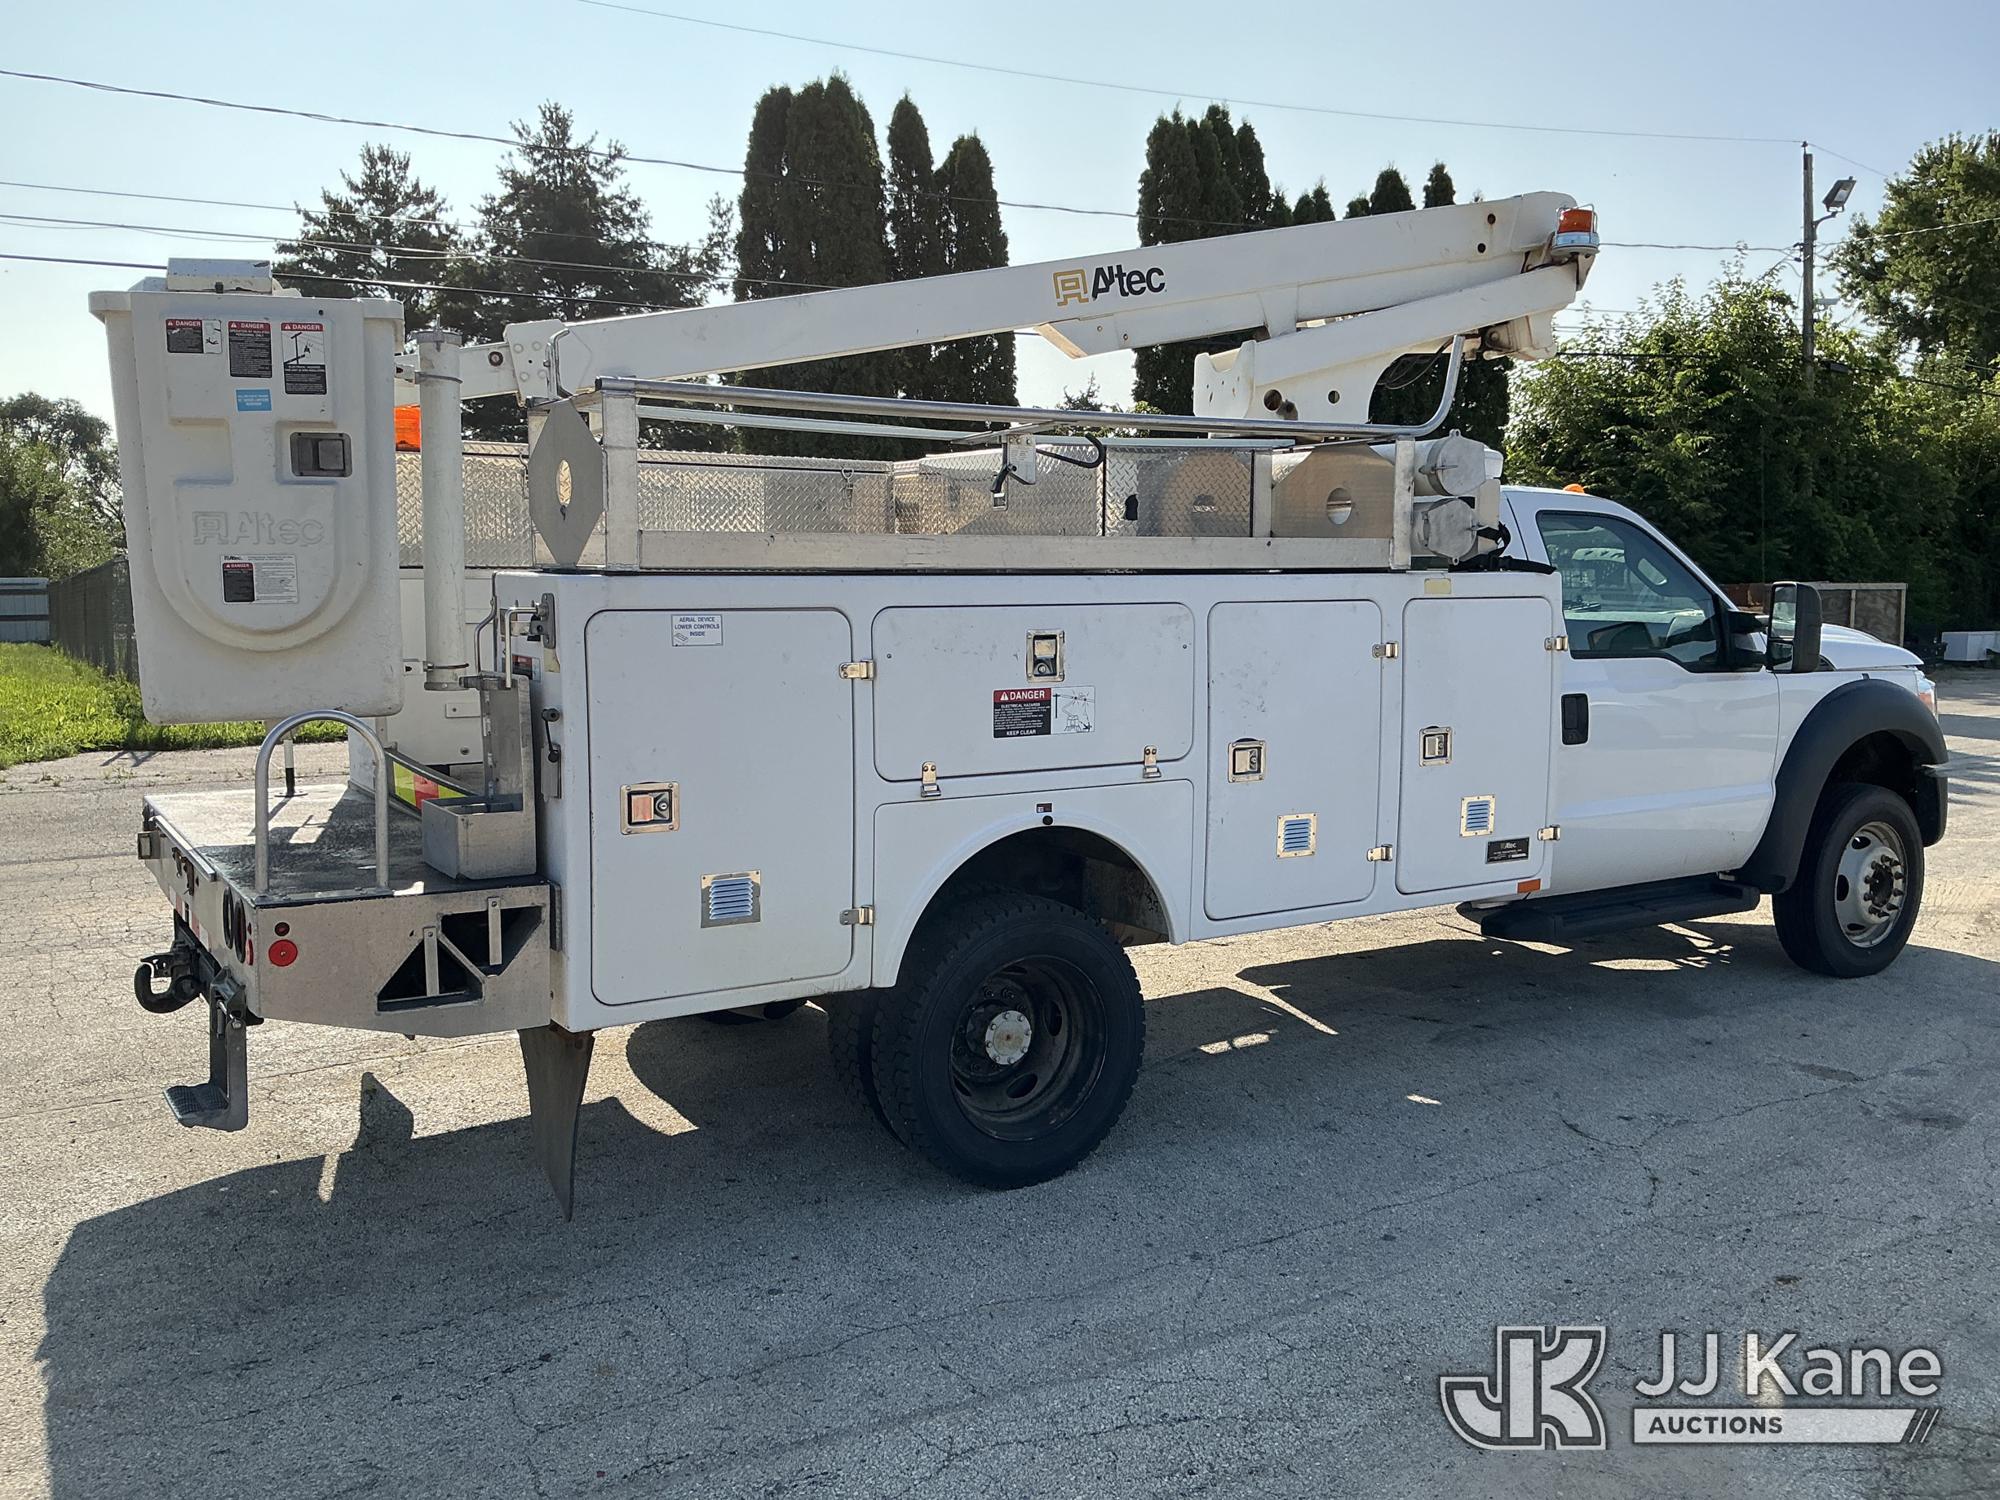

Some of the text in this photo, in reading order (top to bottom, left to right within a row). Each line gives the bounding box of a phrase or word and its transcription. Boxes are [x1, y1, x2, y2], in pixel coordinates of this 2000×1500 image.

[1091, 264, 1166, 301] Altec
[231, 511, 324, 546] Altec
[1010, 690, 1045, 700] DANGER
